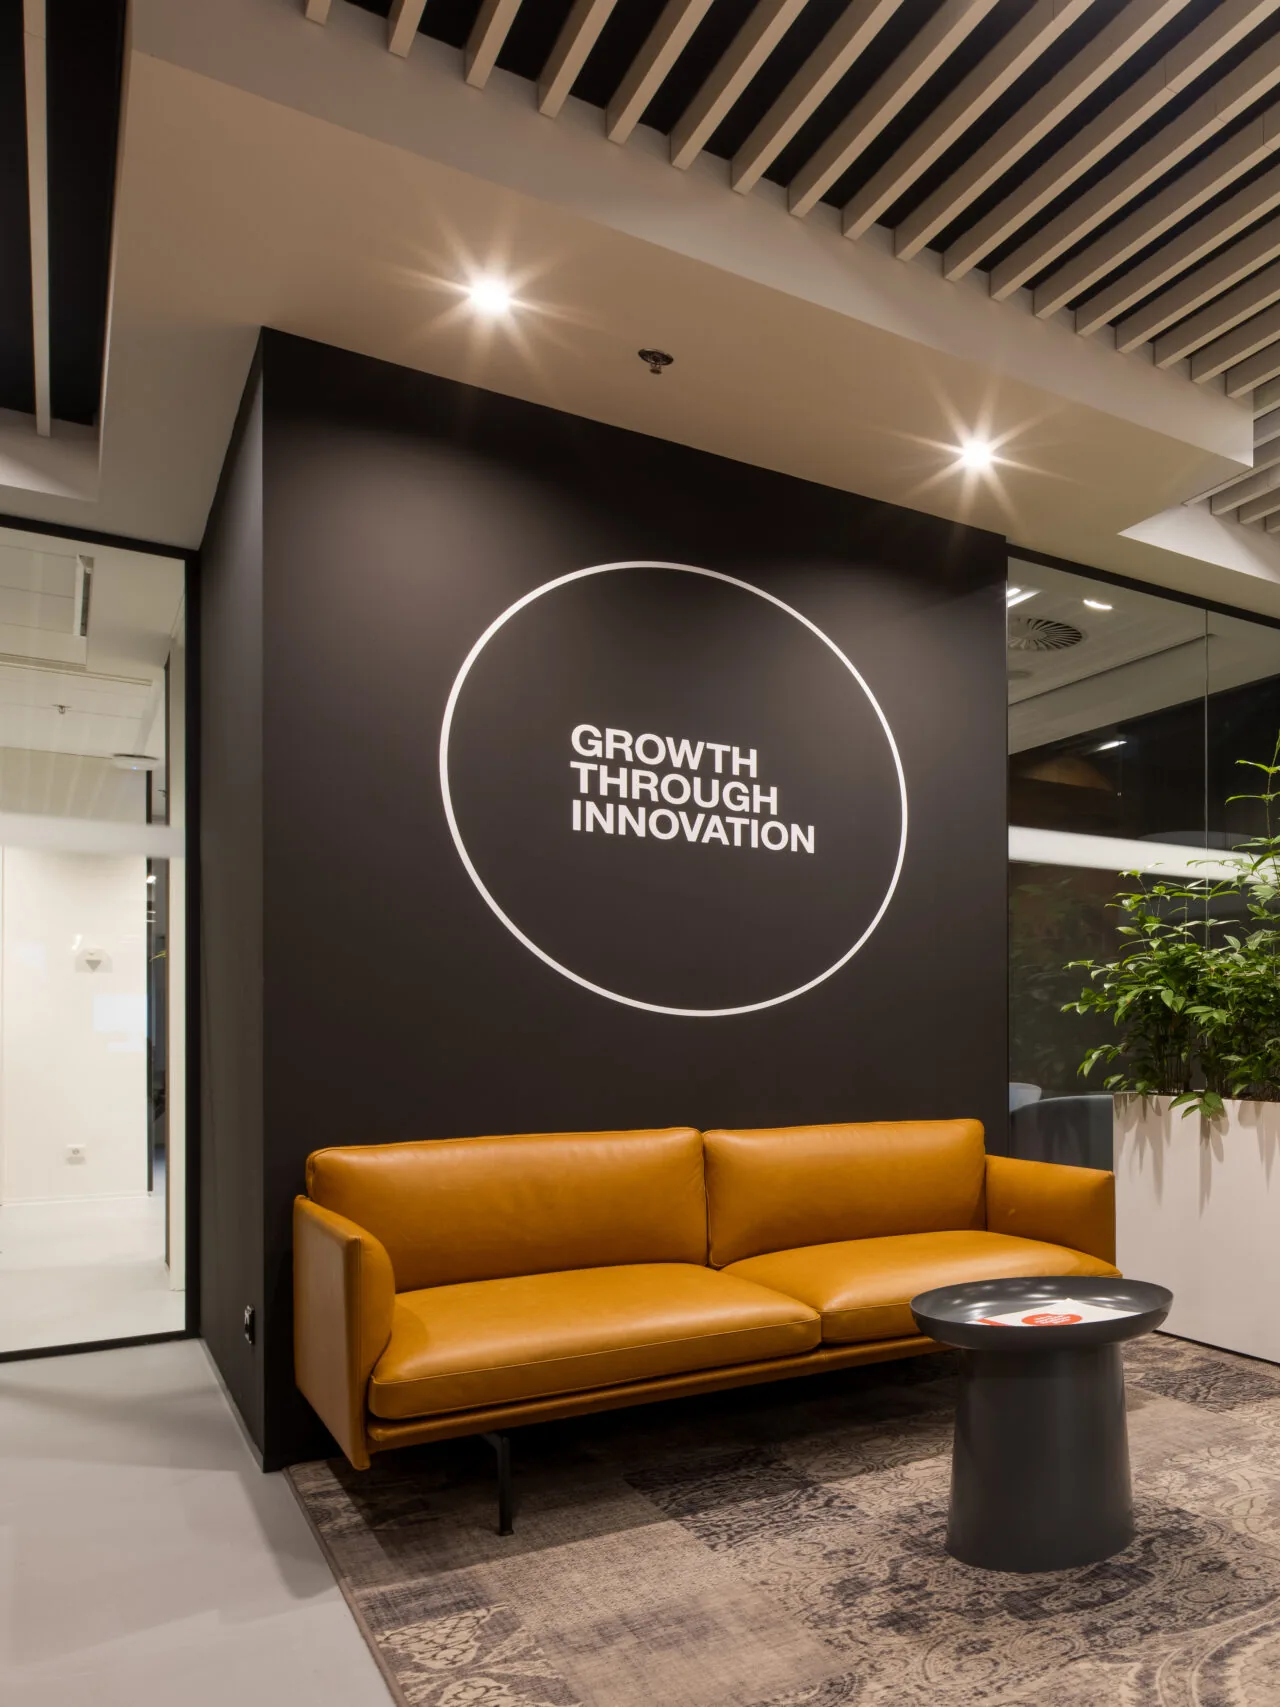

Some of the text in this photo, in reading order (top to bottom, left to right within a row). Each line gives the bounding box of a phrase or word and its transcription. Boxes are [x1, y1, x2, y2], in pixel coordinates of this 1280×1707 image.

[570, 723, 758, 779] GROWTH
[569, 760, 778, 816] THROUGH
[572, 799, 815, 854] INNOVATION
